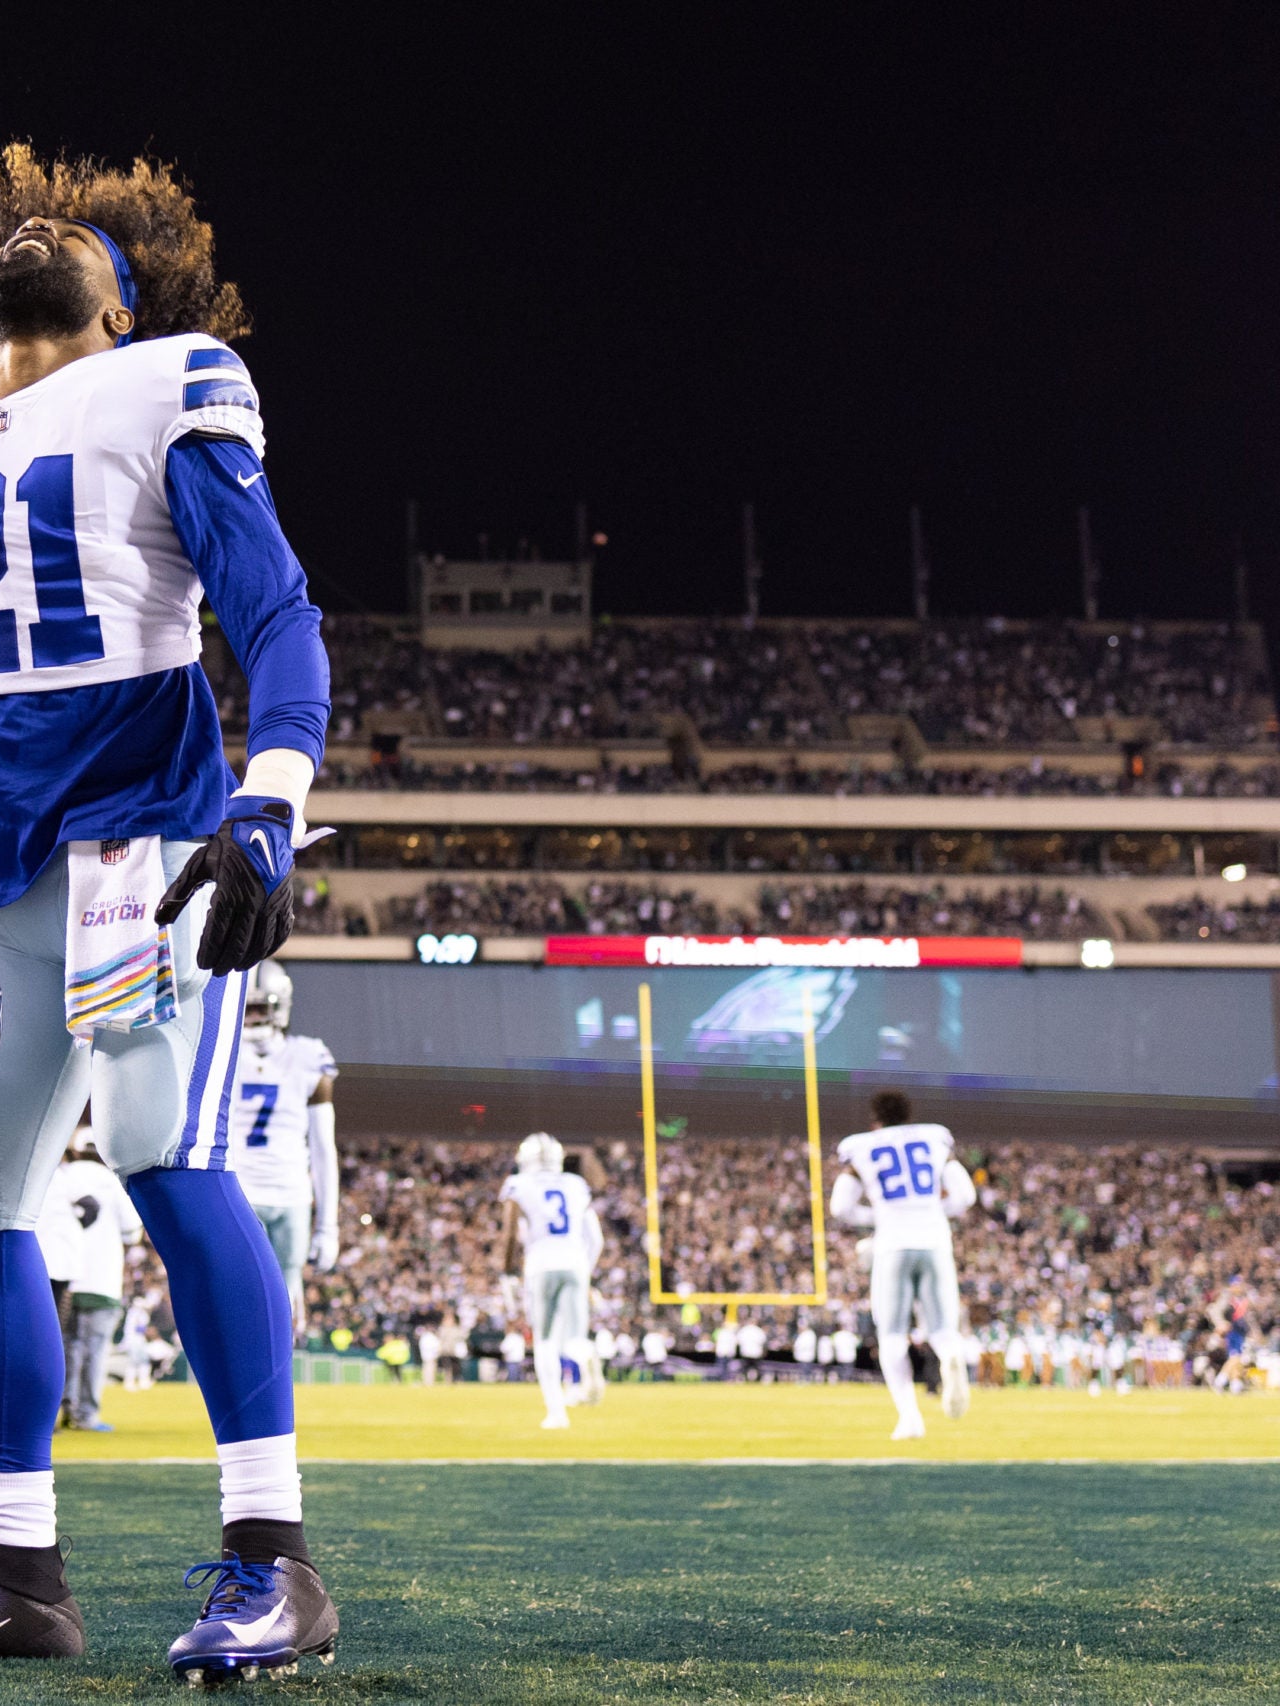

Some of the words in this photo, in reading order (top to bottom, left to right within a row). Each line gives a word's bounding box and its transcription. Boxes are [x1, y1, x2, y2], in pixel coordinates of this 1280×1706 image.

[103, 848, 127, 863] NFL
[80, 903, 147, 927] CATCH
[241, 1083, 278, 1147] 7
[871, 1141, 934, 1200] 26
[545, 1189, 569, 1235] 3
